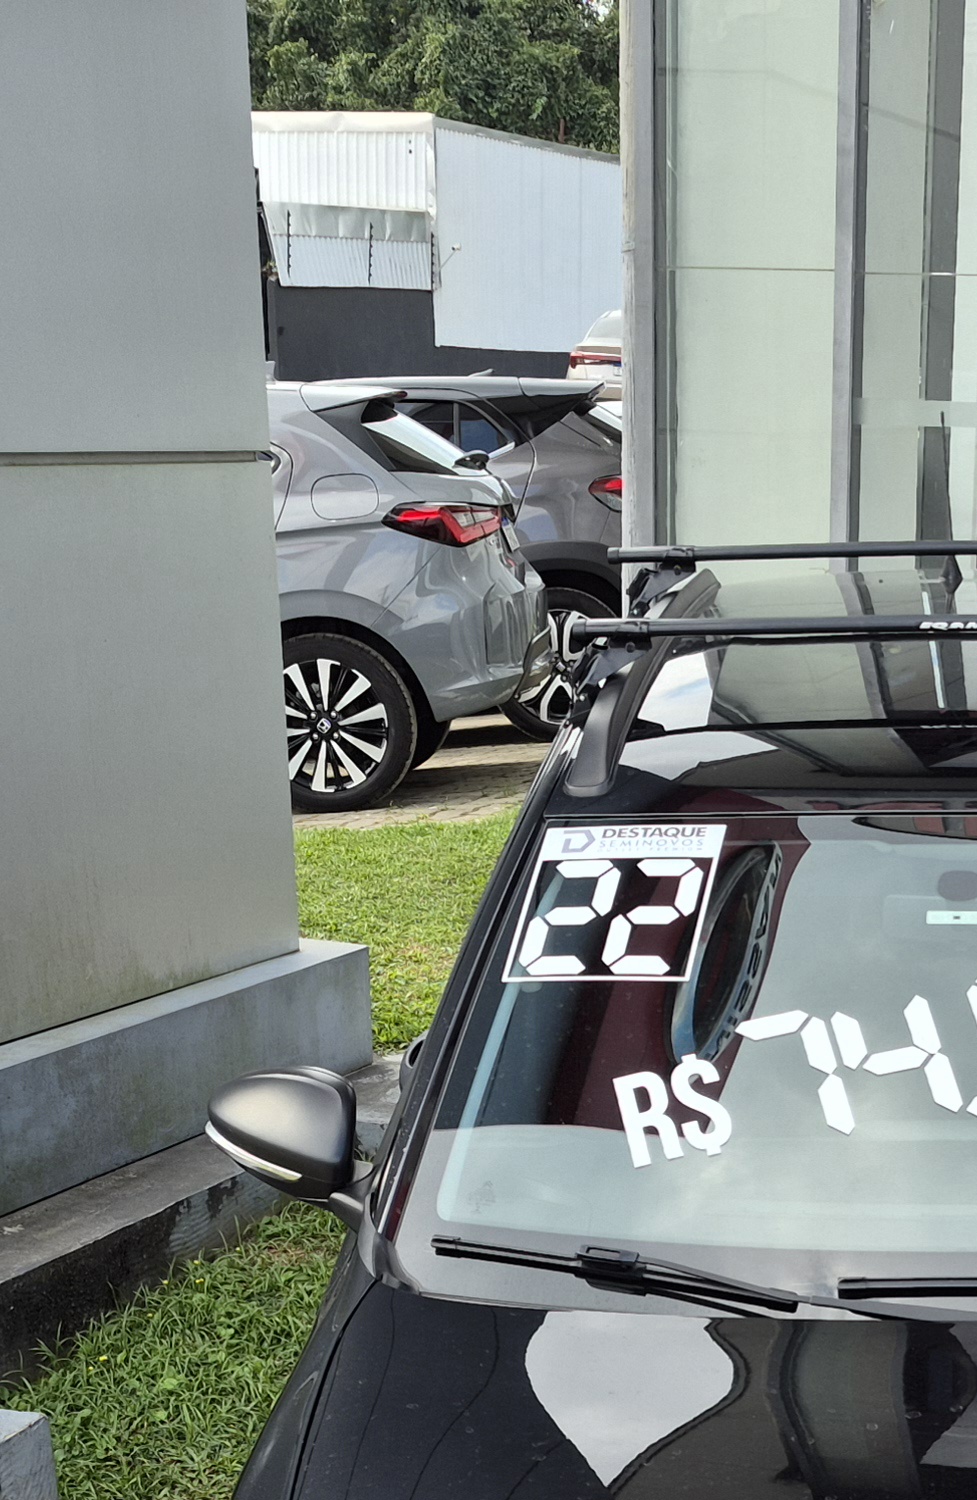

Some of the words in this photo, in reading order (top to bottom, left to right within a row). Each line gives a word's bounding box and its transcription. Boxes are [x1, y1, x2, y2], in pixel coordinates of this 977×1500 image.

[599, 838, 705, 848] SEMINOVOS
[602, 826, 708, 839] DESTAQUE
[518, 859, 704, 976] 22
[613, 1053, 733, 1169] R$
